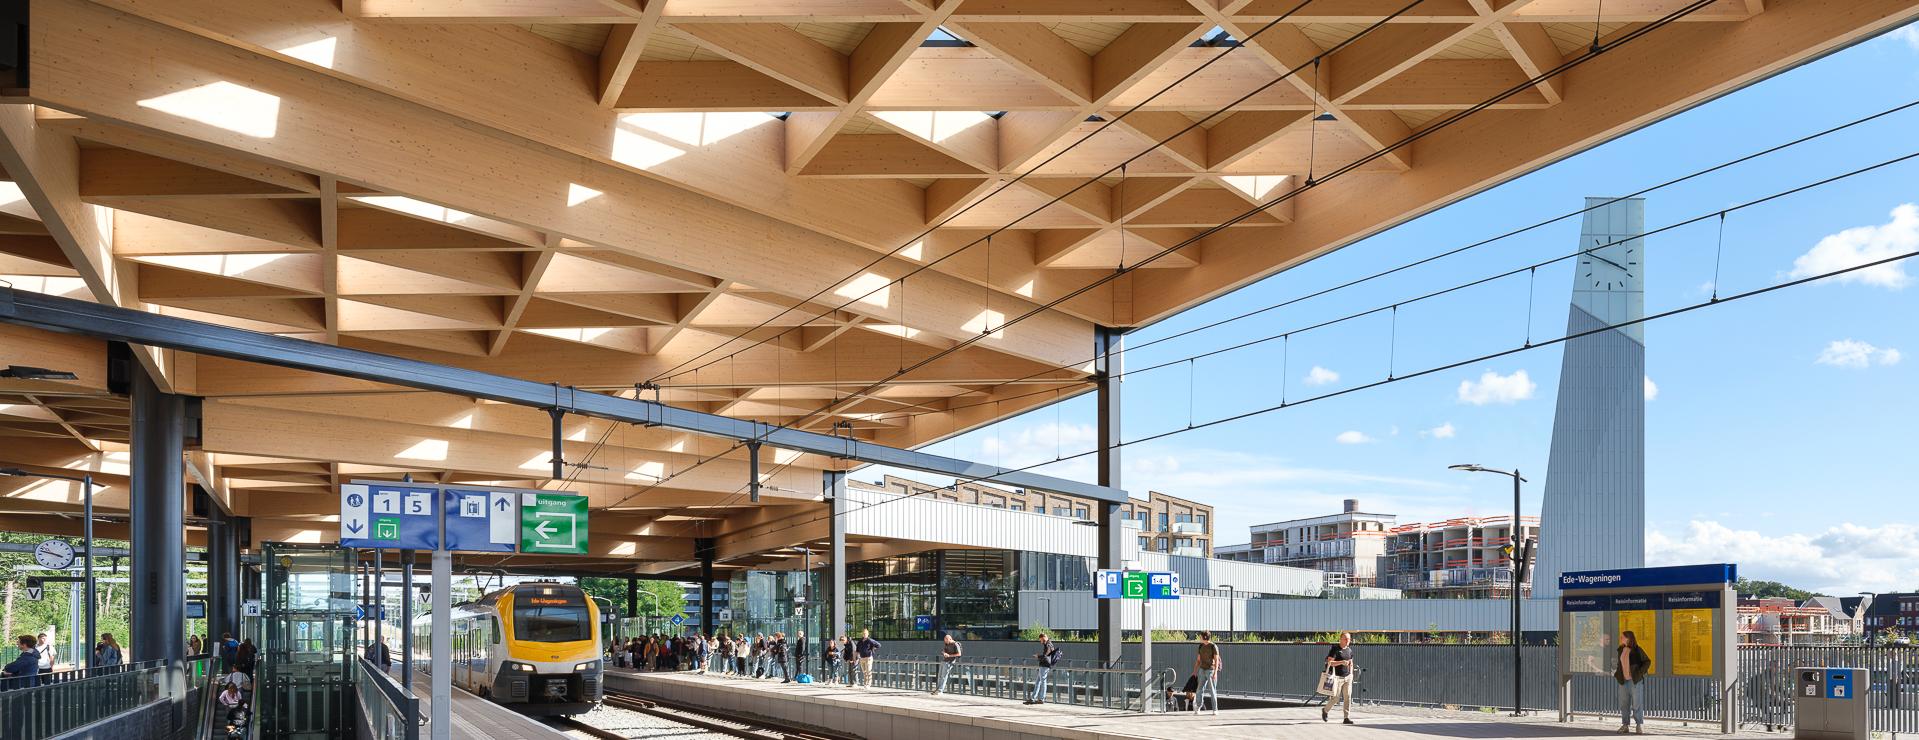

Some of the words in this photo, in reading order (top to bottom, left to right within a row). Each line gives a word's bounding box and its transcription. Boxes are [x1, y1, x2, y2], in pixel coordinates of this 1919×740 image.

[383, 499, 390, 511] 1
[412, 500, 422, 513] 5
[537, 498, 567, 507] uitgang
[1563, 573, 1621, 584] Ede-Wageningen
[28, 589, 40, 599] V
[420, 593, 431, 603] V
